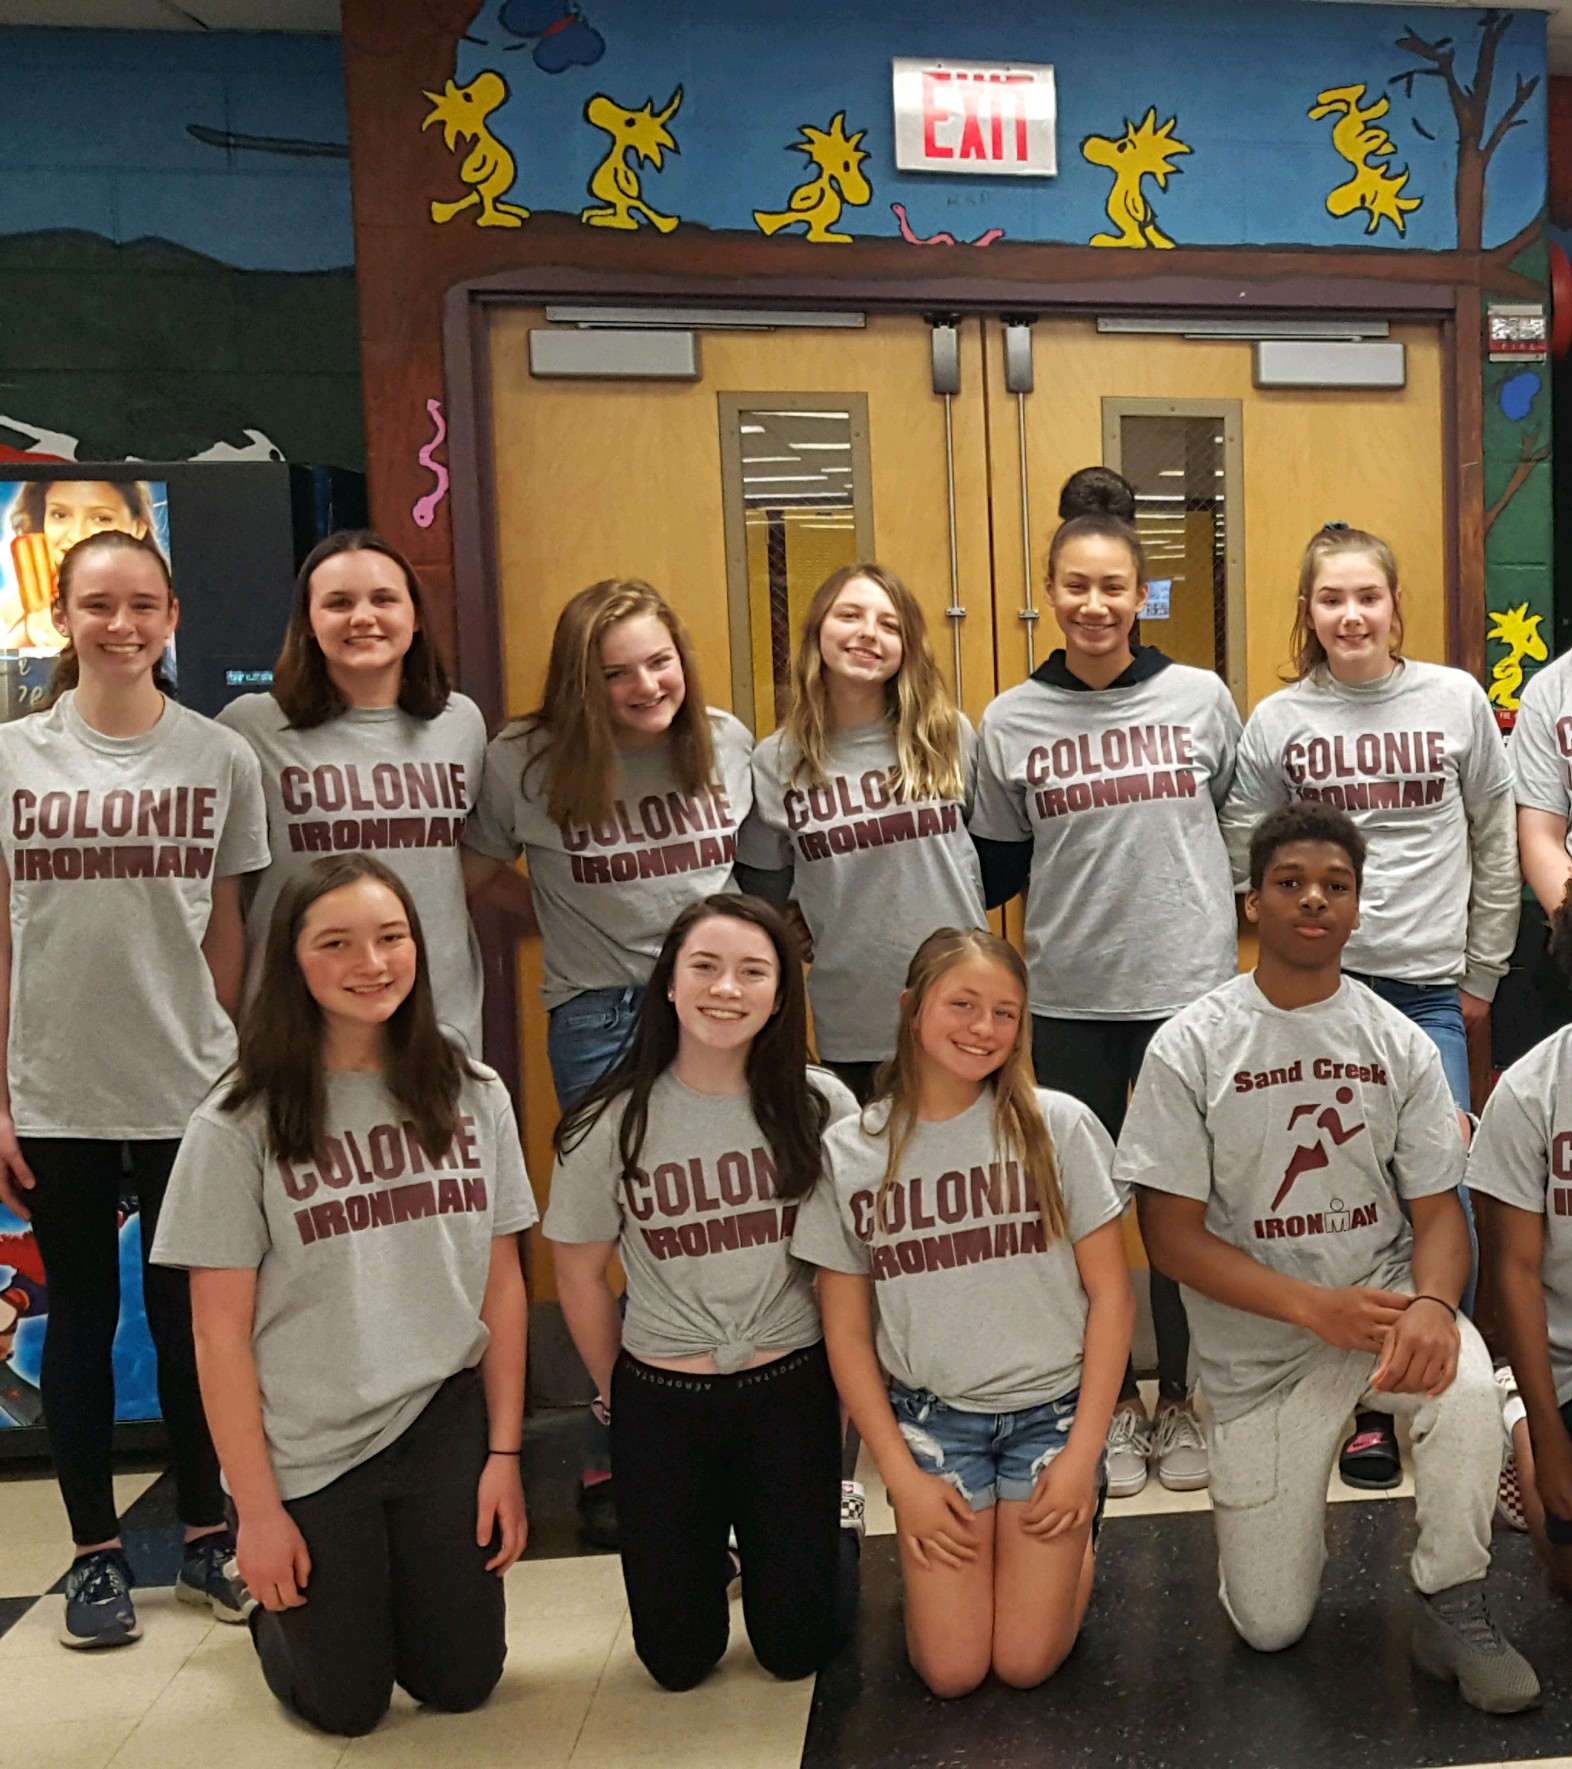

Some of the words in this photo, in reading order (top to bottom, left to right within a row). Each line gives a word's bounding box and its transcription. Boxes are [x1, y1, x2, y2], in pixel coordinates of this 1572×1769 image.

[922, 72, 1034, 161] EXIT
[1026, 725, 1193, 786] COLONIE
[1285, 731, 1445, 784] COLONIE
[13, 786, 217, 840] COLONIE
[280, 763, 467, 815] COLONIE
[783, 765, 916, 831] COLO
[1035, 770, 1197, 819] IRONMAN
[1298, 778, 1446, 811] RONMAN
[288, 817, 466, 852] IRONMAN
[571, 831, 738, 884] IRONMAN
[797, 805, 958, 862] IRONMAN
[14, 846, 215, 881] IRONMAN
[1233, 1060, 1303, 1093] Sand
[1313, 1058, 1388, 1086] Creek
[624, 1146, 779, 1221] COLON
[294, 1177, 488, 1246] IRONMAN
[640, 1204, 799, 1261] IRONMA
[1254, 1200, 1379, 1239] IRONMAN
[872, 1219, 1048, 1281] RONMAN
